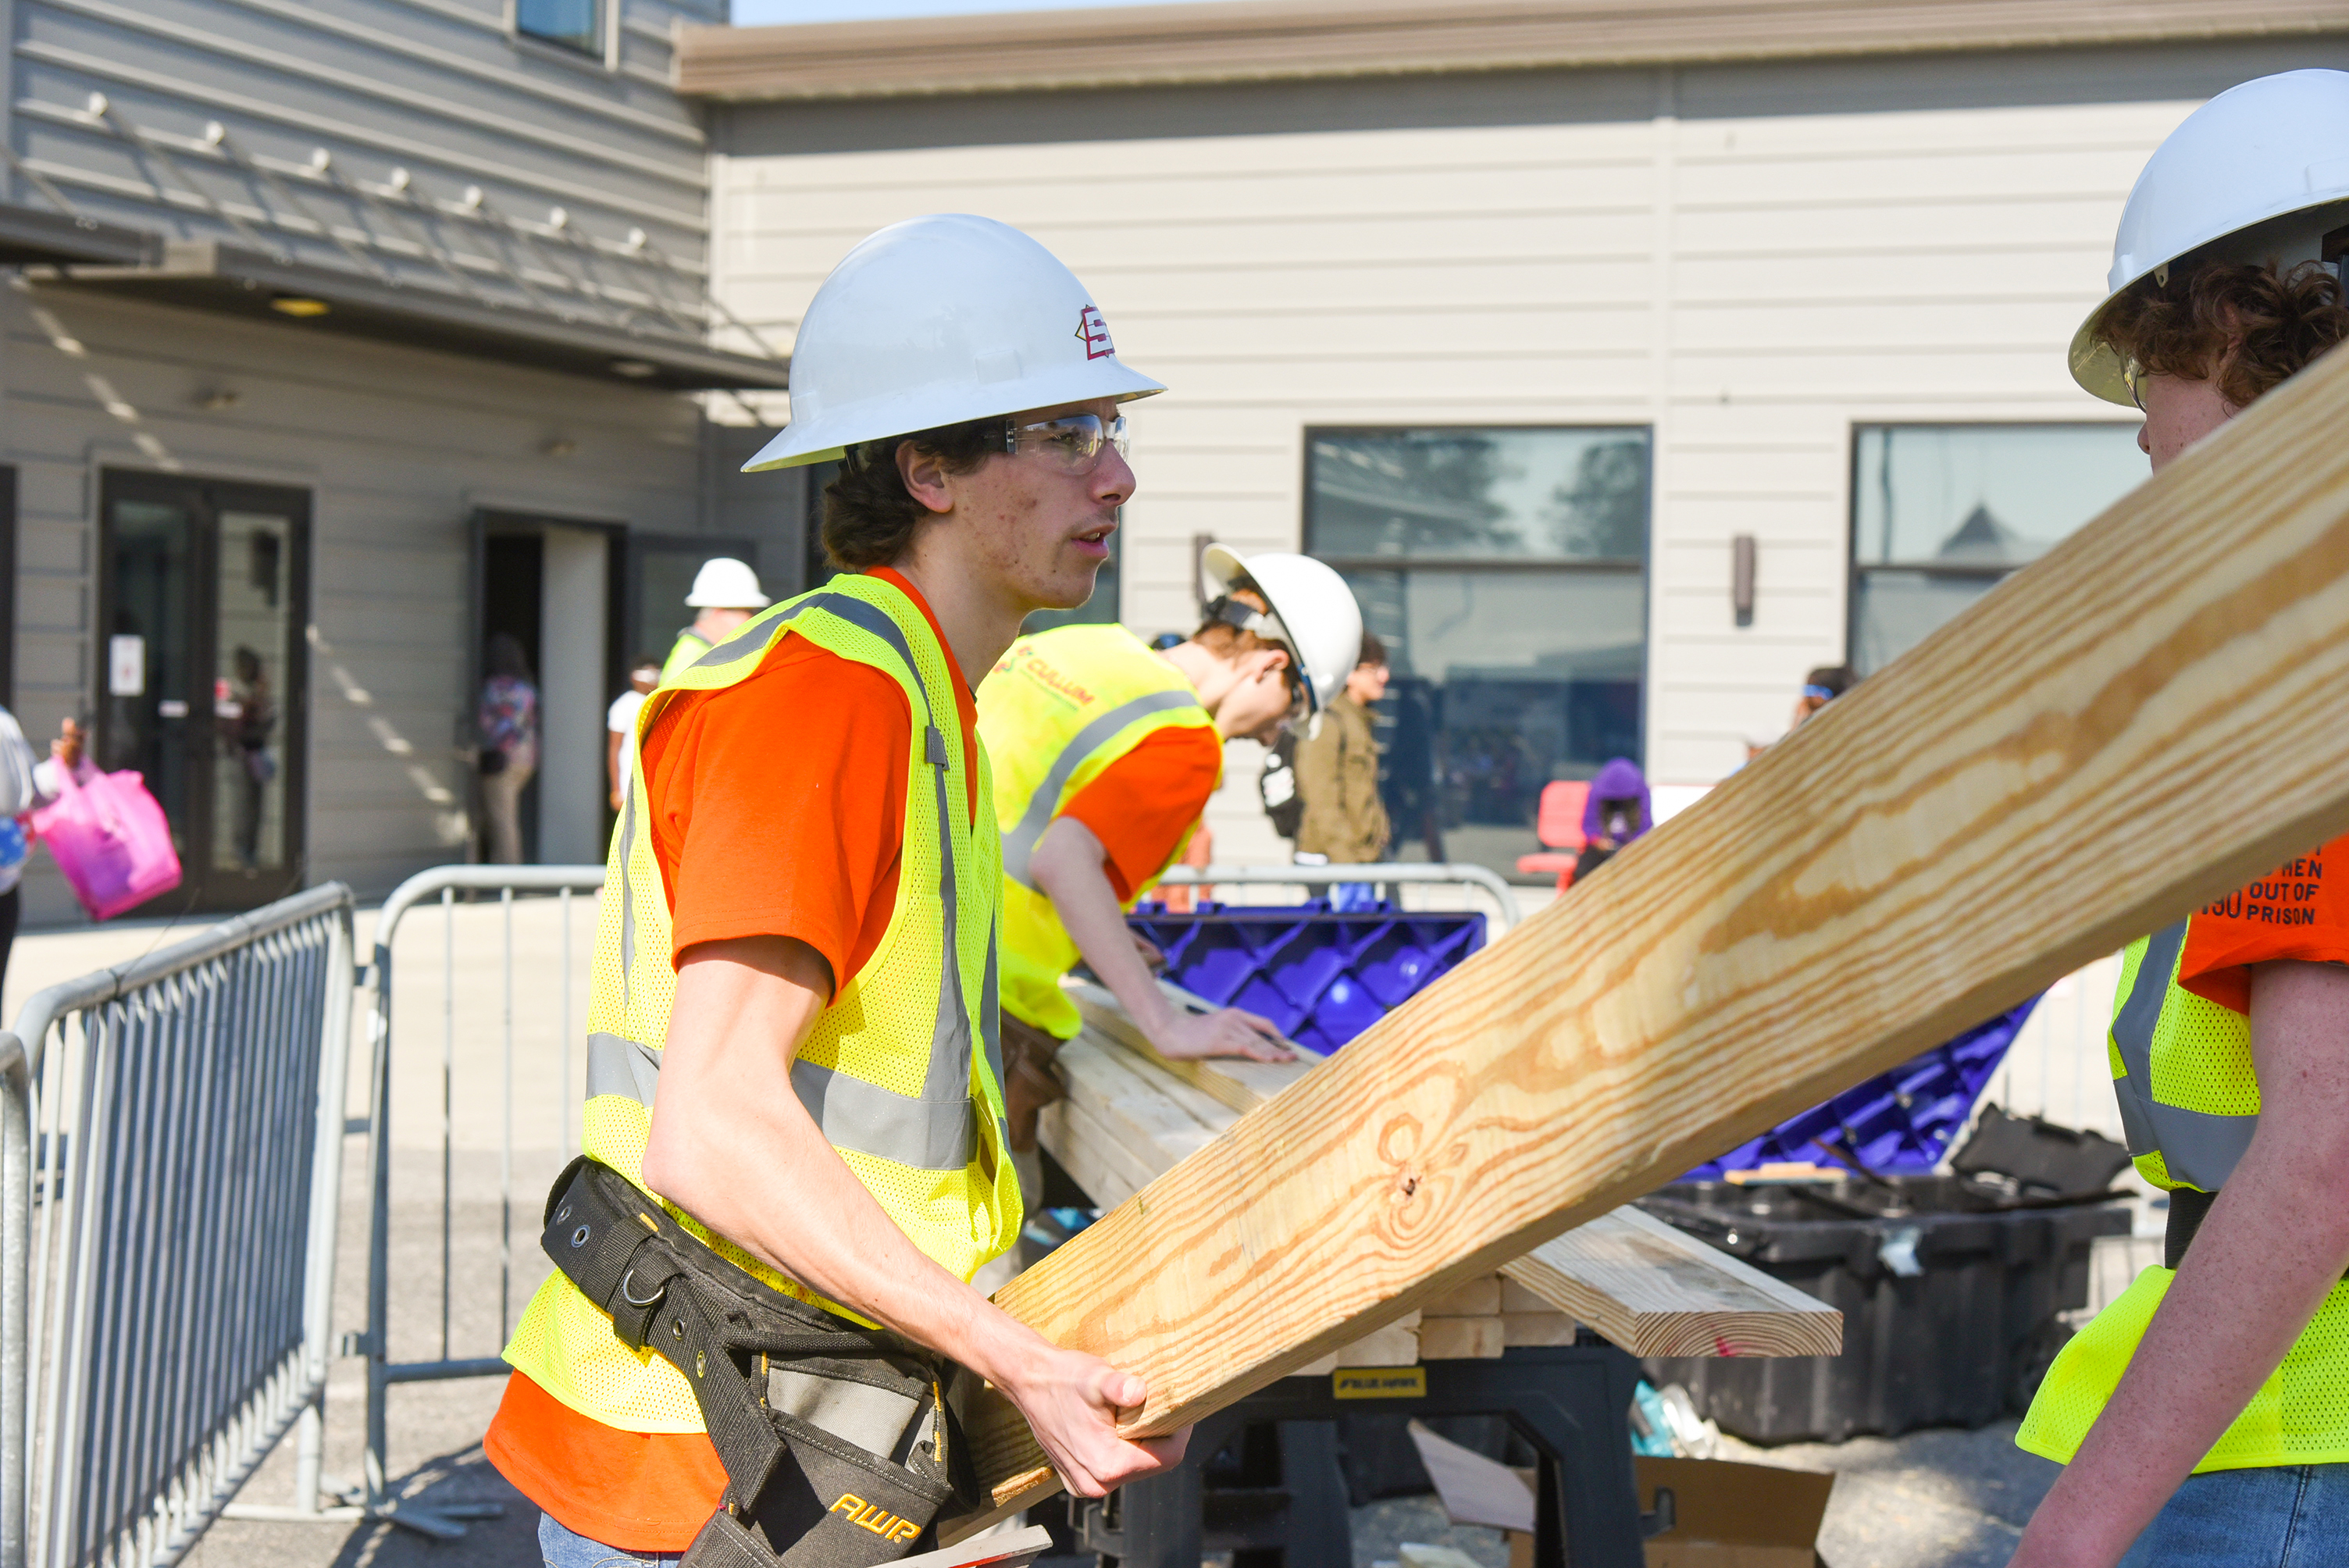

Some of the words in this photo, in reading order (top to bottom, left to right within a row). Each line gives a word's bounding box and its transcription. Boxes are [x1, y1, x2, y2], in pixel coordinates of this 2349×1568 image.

[2249, 881, 2290, 901] OUT
[2294, 882, 2319, 902] OF
[2247, 903, 2315, 925] PRISON
